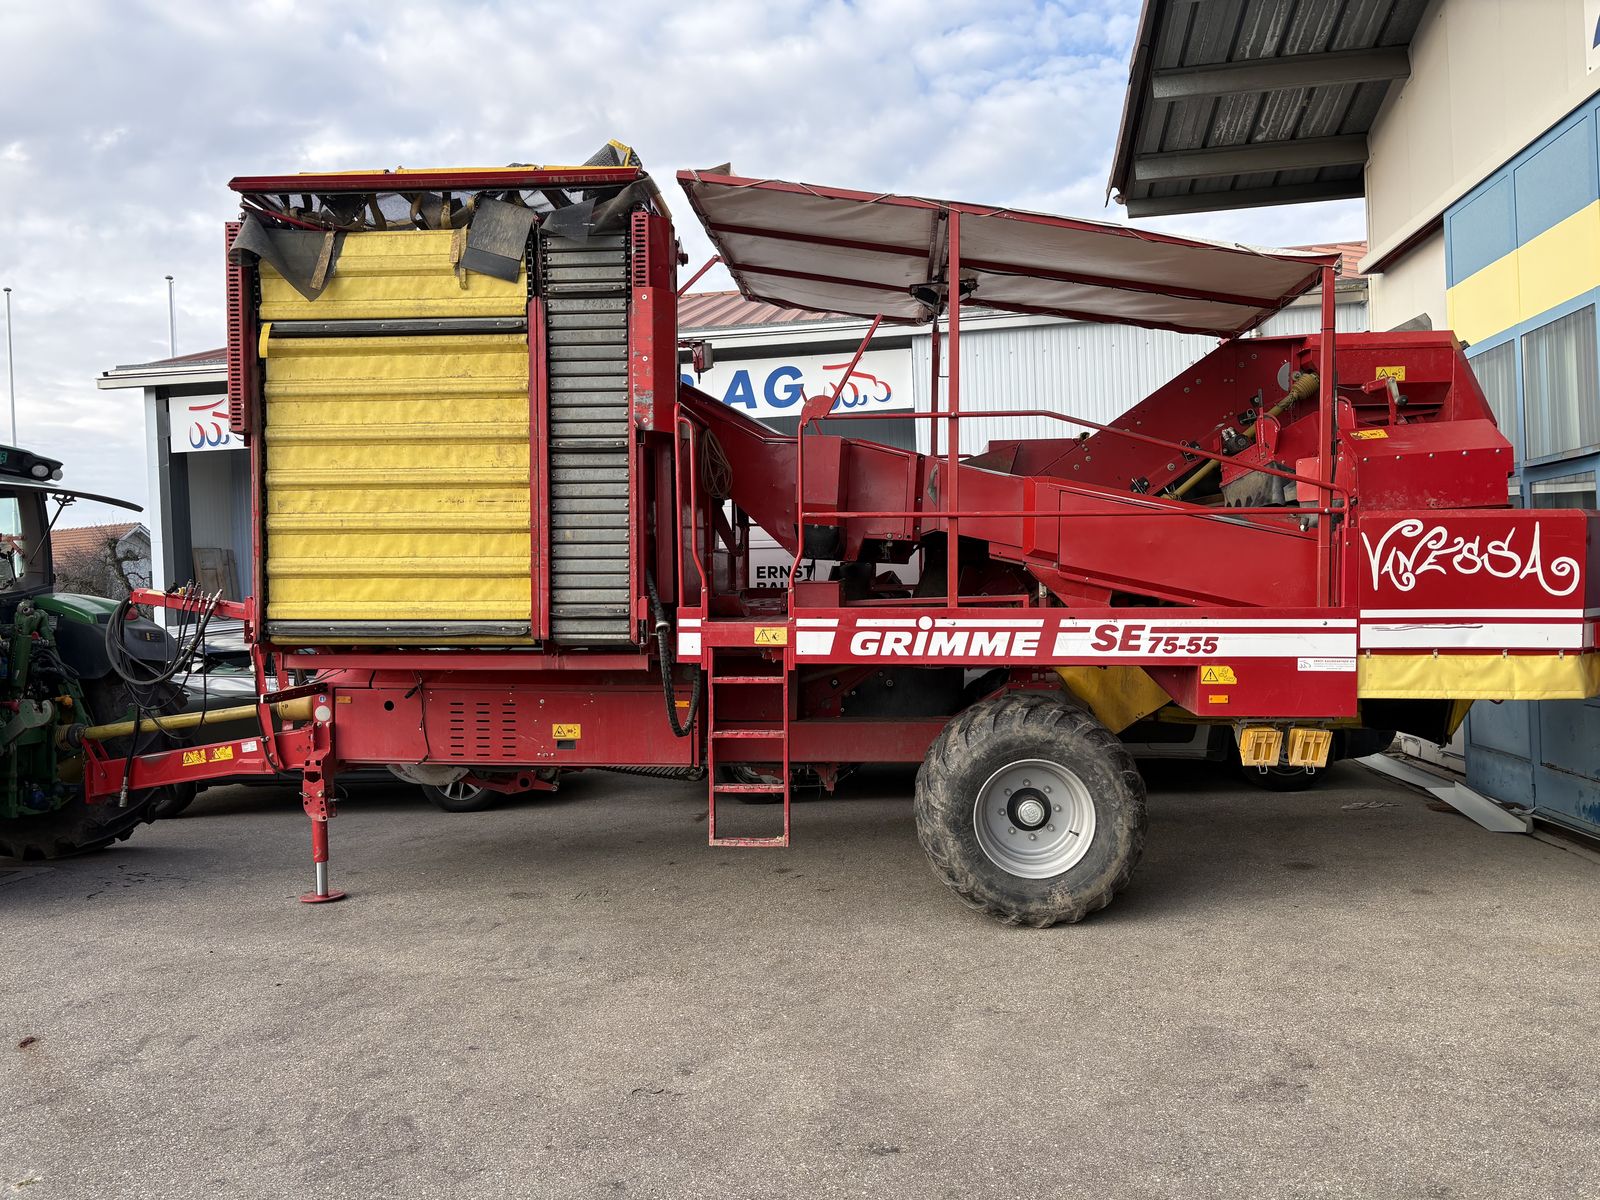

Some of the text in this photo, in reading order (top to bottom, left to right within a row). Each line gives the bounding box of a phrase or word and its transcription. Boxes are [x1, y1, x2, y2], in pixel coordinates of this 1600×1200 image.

[722, 366, 804, 409] AG
[756, 565, 812, 579] ERNST
[1361, 518, 1580, 597] VANESSA
[1090, 624, 1219, 654] SE 75-55
